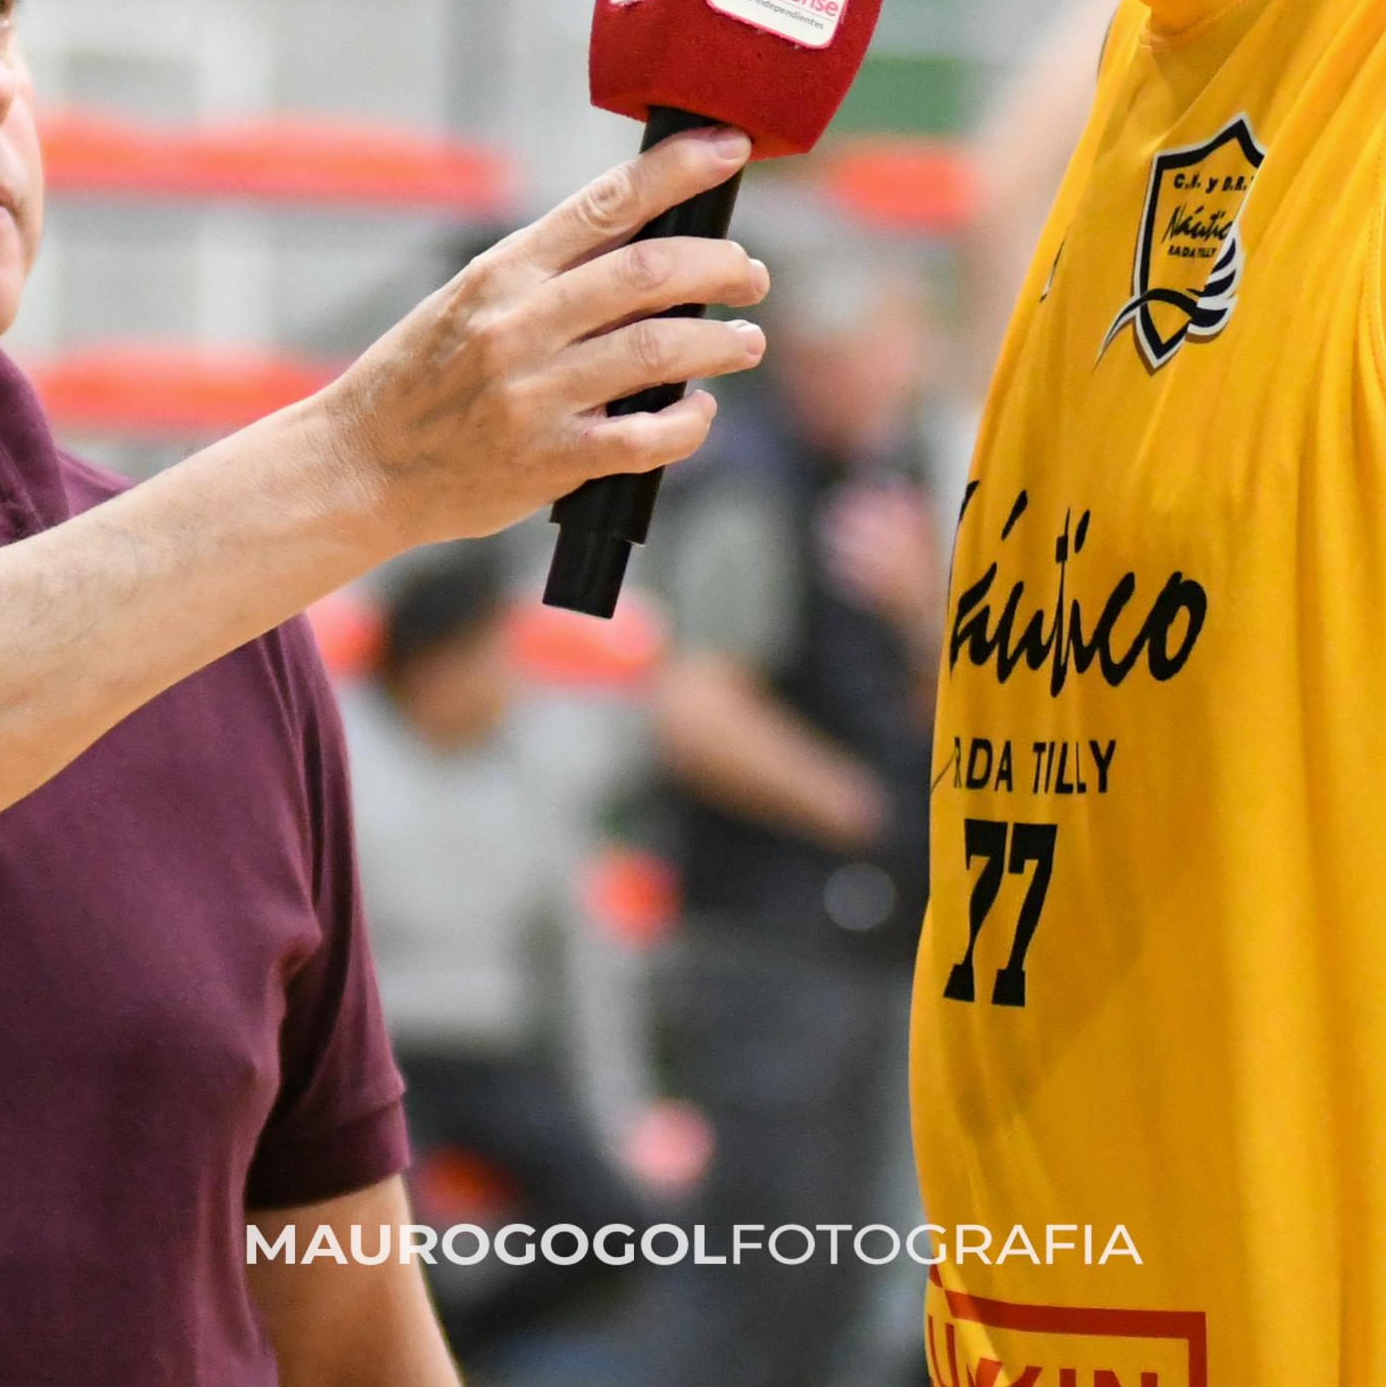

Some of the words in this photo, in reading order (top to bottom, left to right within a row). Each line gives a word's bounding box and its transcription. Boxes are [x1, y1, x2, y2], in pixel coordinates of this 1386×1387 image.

[1161, 203, 1234, 244] Náutic
[948, 480, 1207, 698] áutico
[1033, 739, 1116, 794] TILLY
[943, 818, 1058, 1008] 77
